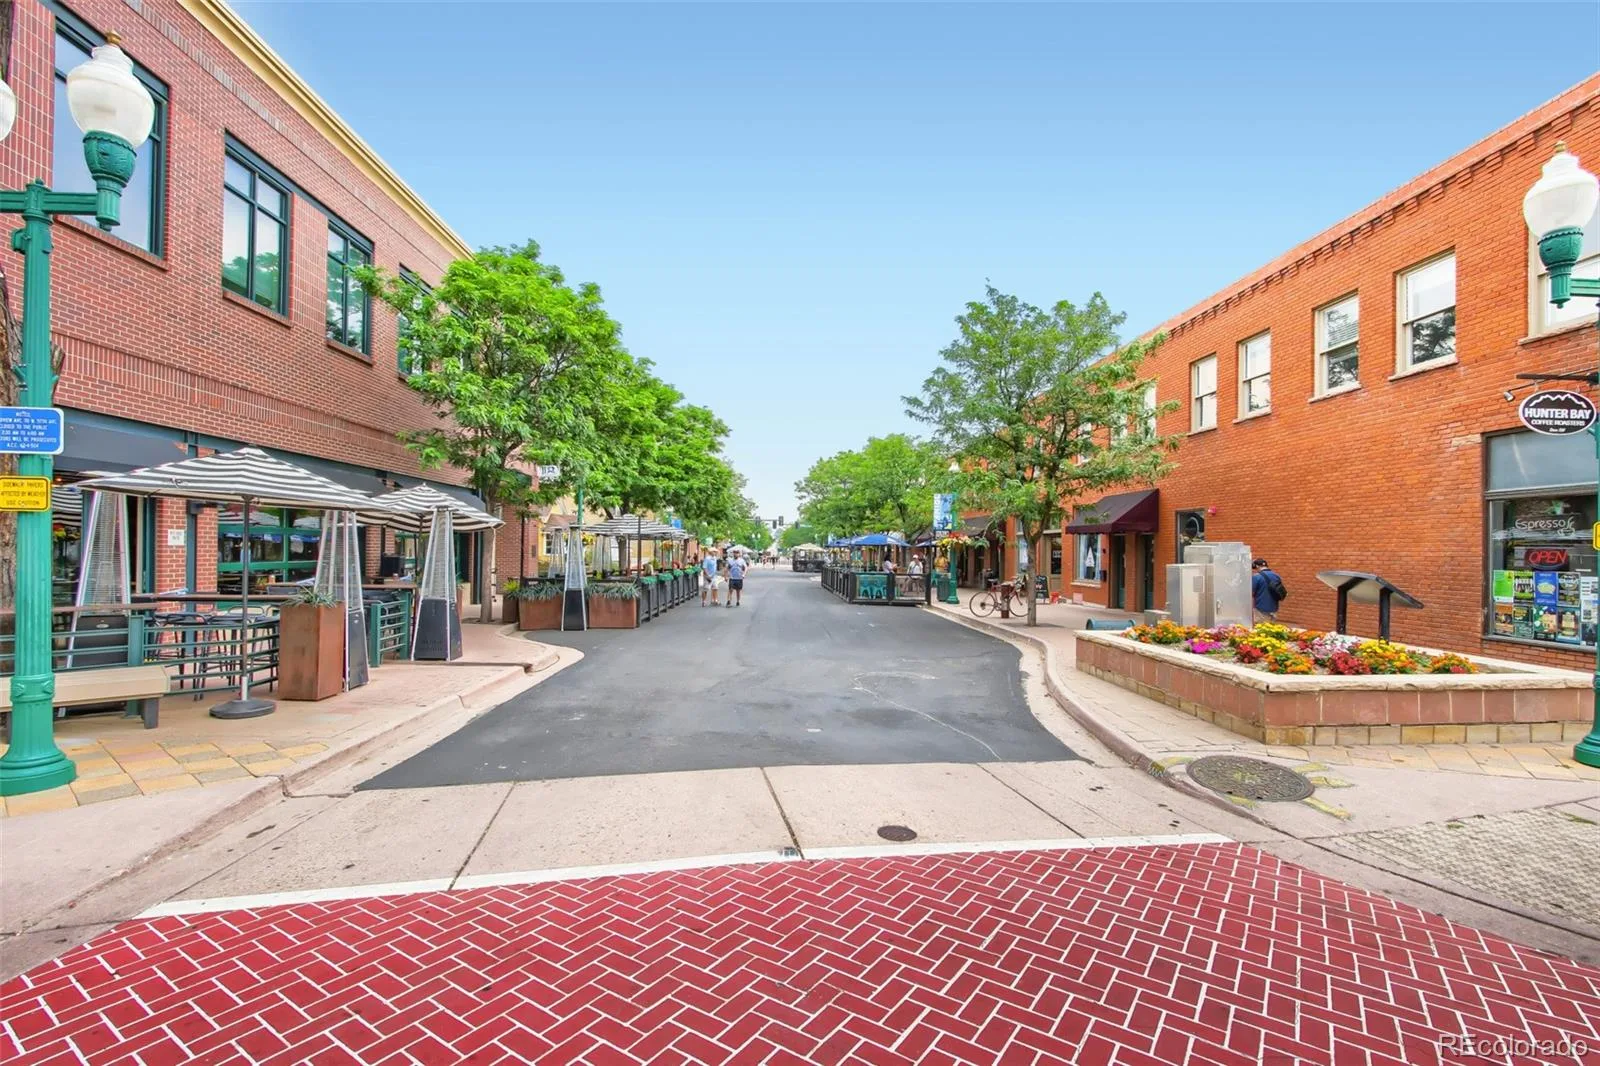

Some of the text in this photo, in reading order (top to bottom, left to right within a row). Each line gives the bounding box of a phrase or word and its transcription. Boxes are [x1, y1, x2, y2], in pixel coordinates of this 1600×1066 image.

[1524, 407, 1592, 419] HUNTER BAY
[1515, 519, 1566, 531] Espresso
[1528, 549, 1568, 564] OPEN
